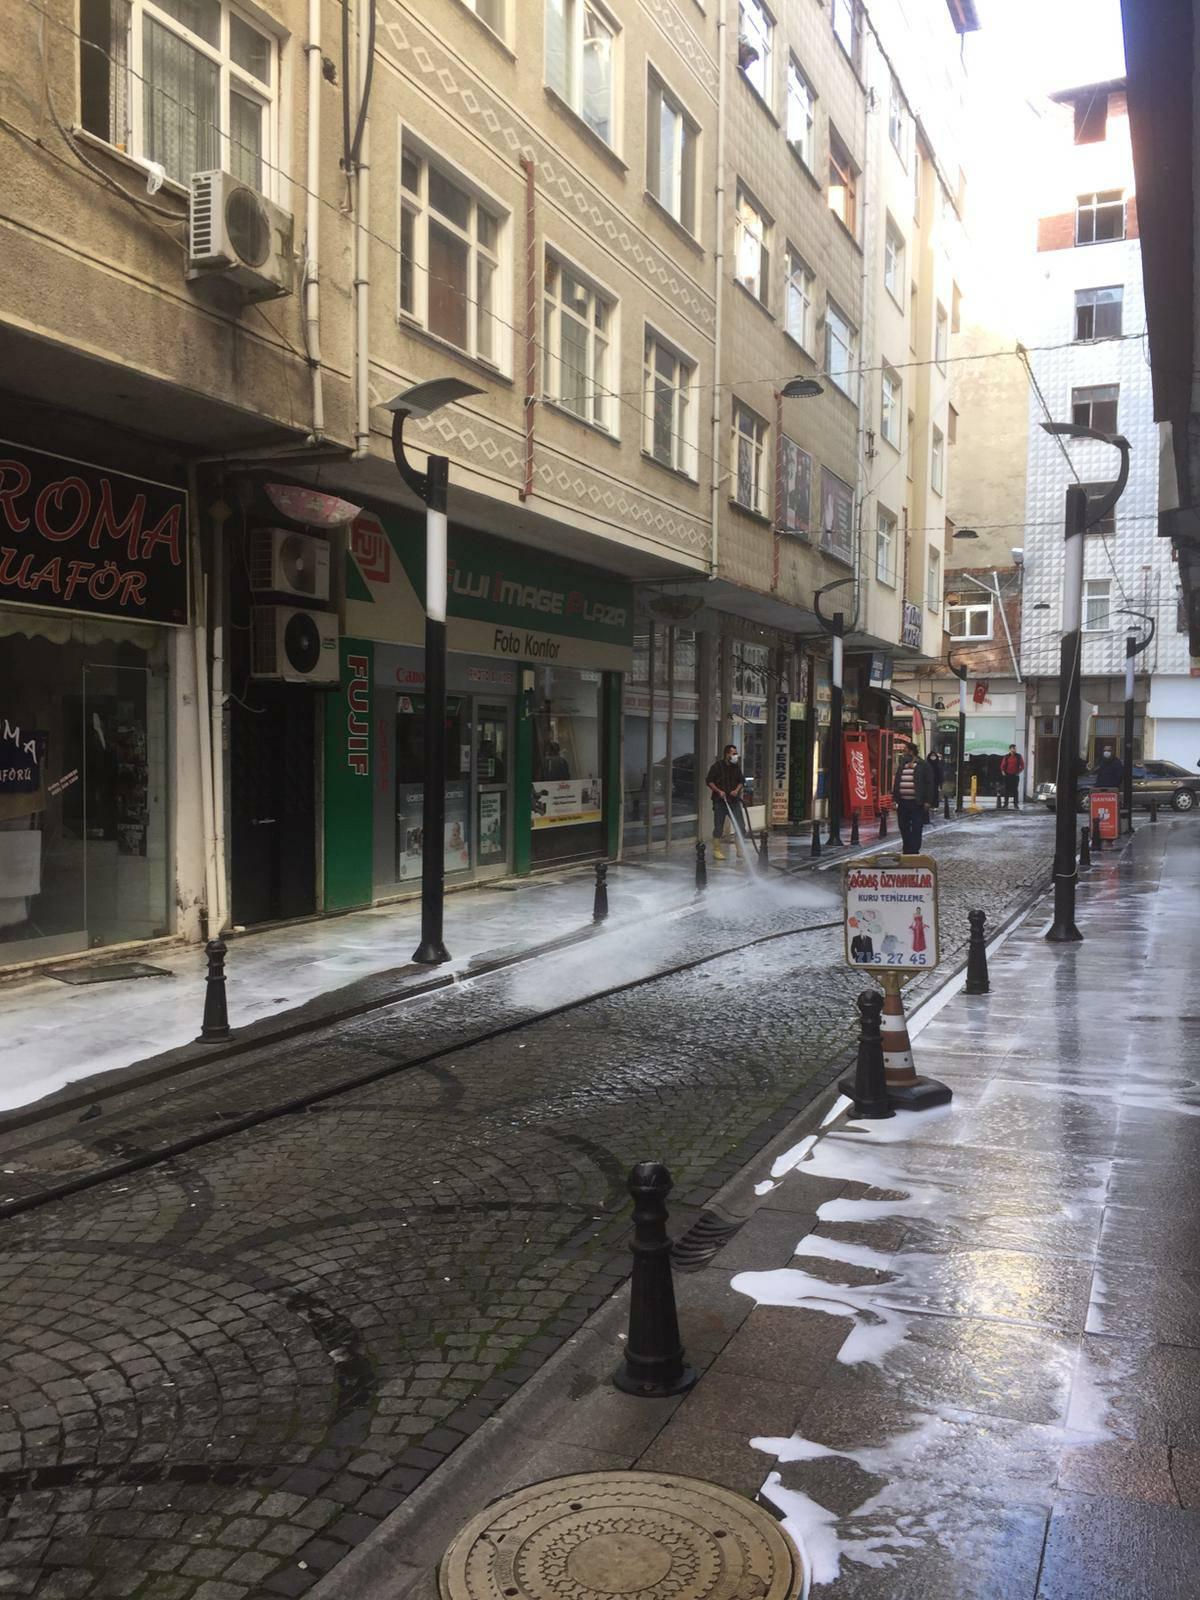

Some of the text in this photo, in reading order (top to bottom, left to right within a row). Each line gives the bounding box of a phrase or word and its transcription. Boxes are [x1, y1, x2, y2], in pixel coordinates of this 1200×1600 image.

[493, 629, 561, 659] Foto Konfor
[395, 666, 425, 684] Cano
[858, 894, 879, 902] KURU
[887, 953, 903, 964] 27
[909, 953, 926, 965] 45
